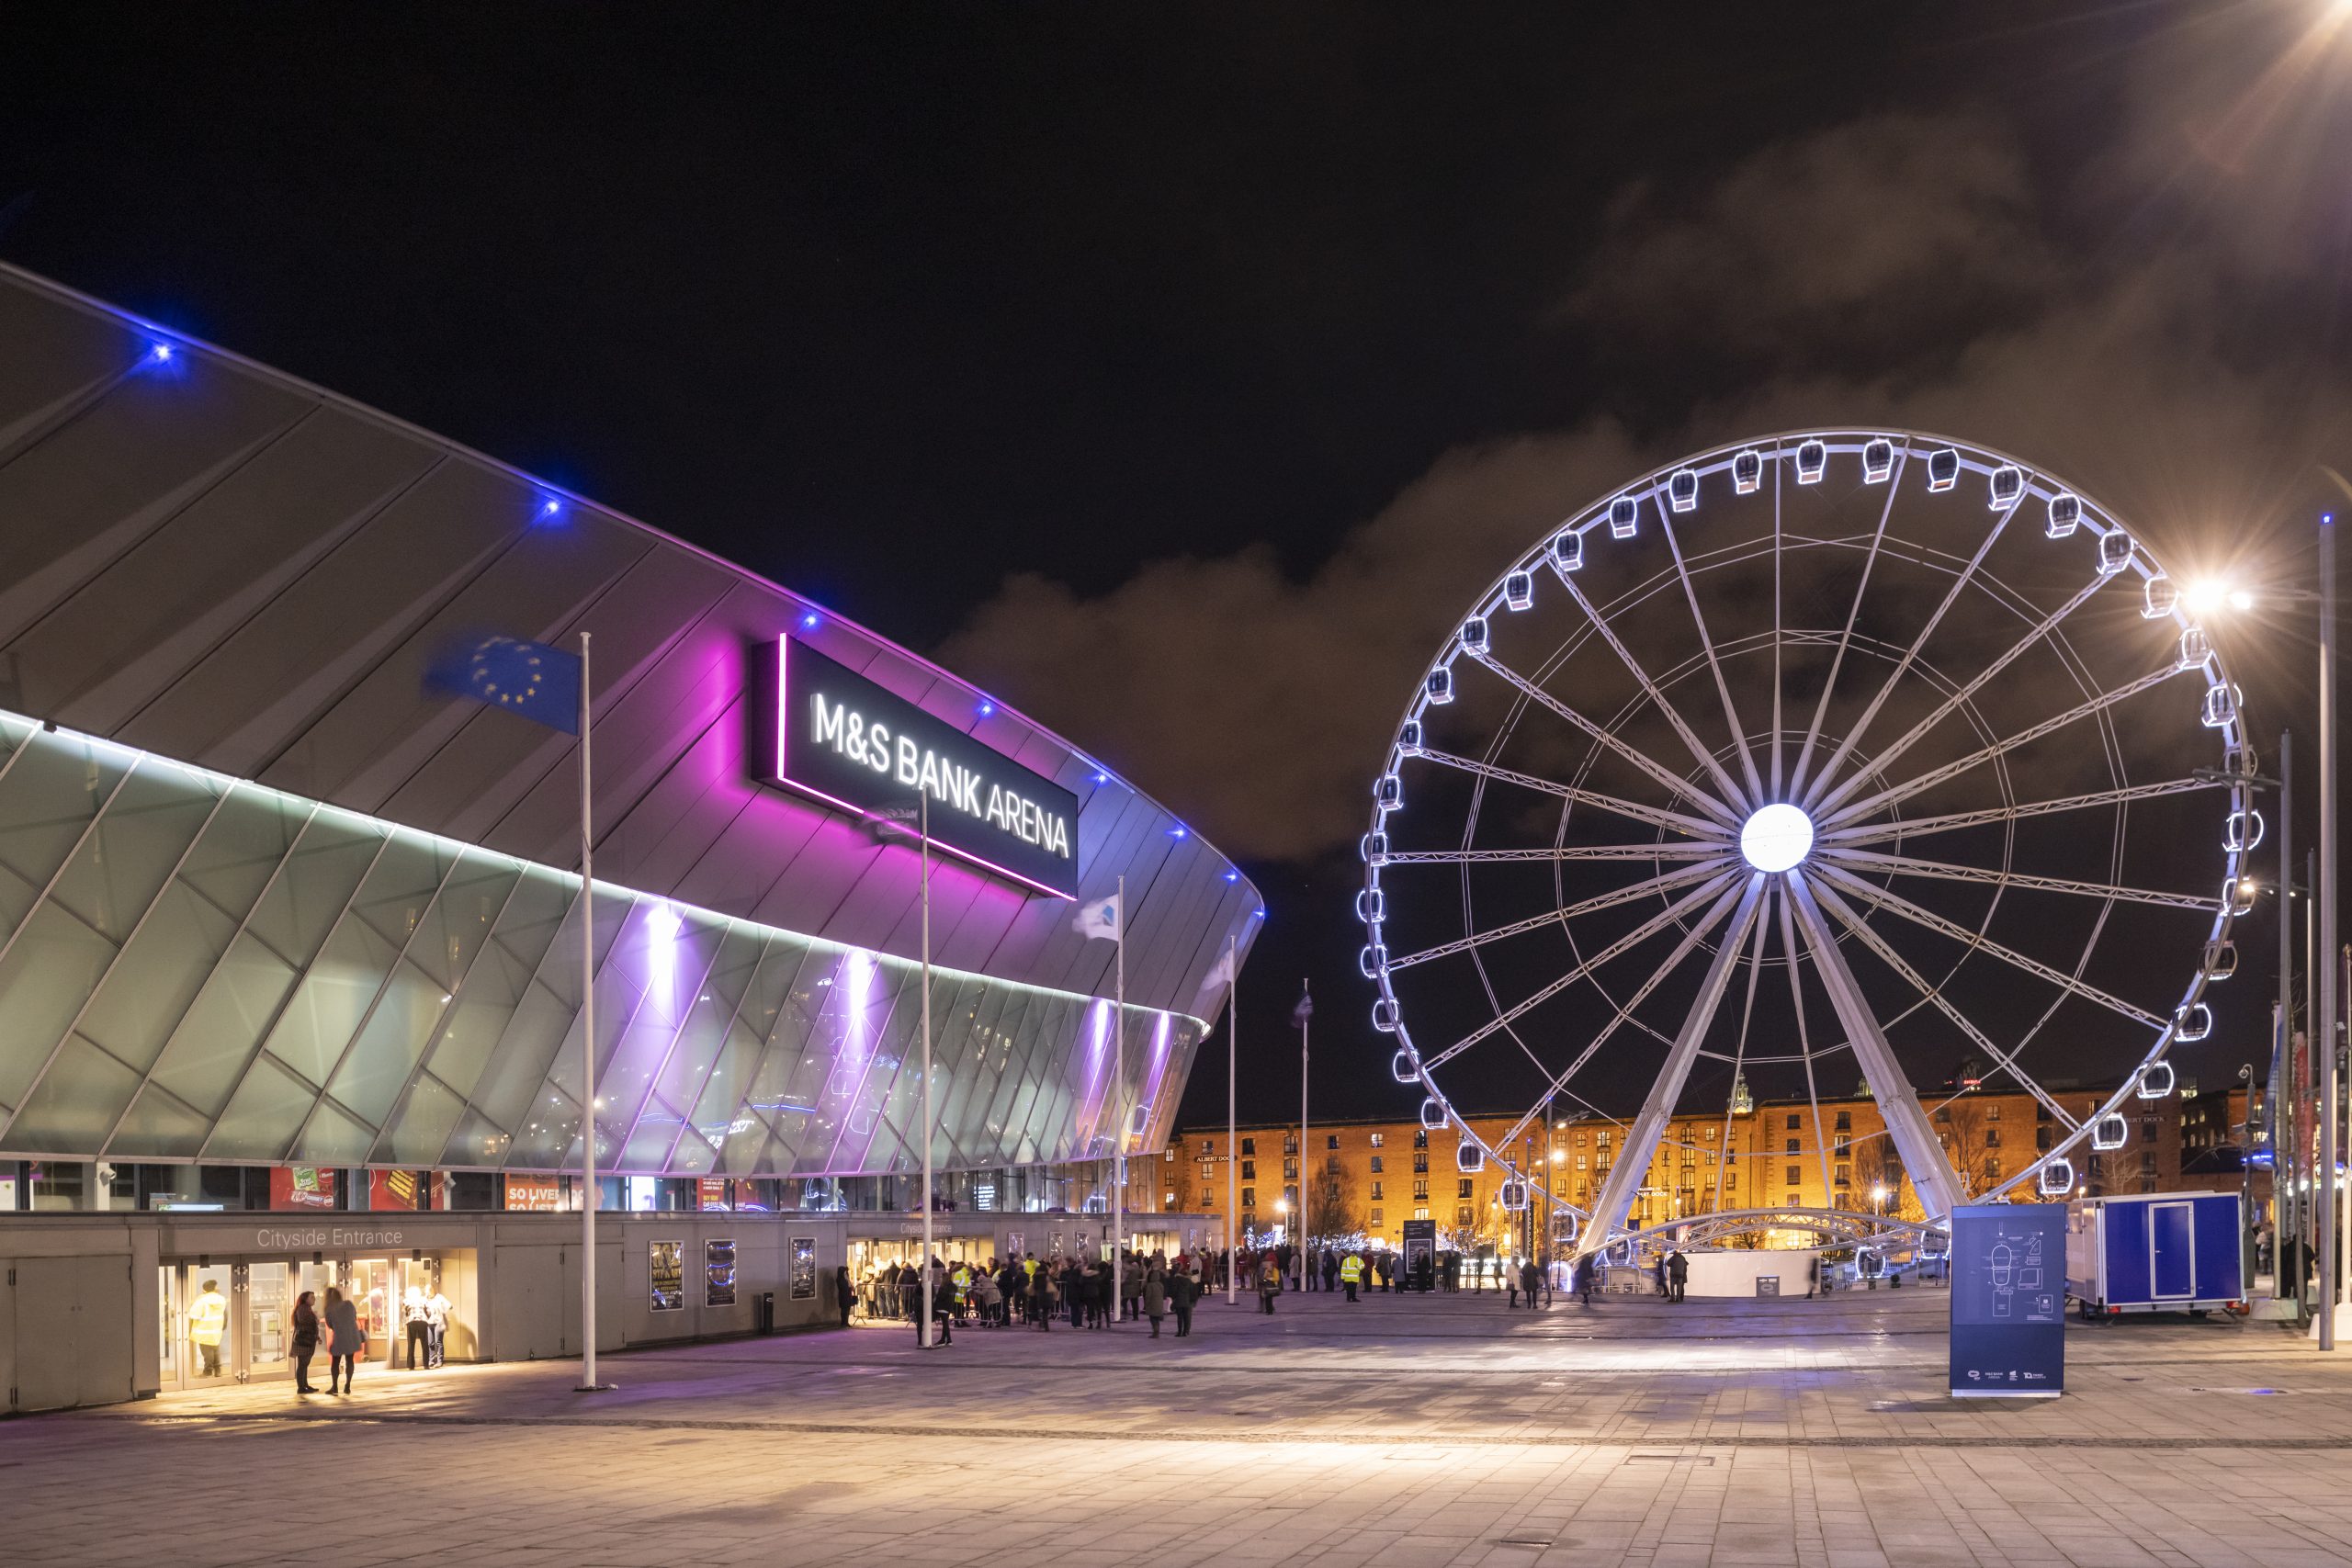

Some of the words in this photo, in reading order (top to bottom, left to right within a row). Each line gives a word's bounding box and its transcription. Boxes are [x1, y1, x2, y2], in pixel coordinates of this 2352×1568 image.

[812, 694, 891, 773] M&S
[895, 735, 981, 818] BANK
[985, 784, 1069, 859] ARENA
[508, 1188, 526, 1200] SO
[900, 1223, 924, 1235] Cityside
[931, 1223, 952, 1234] ntrance
[257, 1228, 326, 1249] Cityside
[333, 1228, 402, 1246] Entrance
